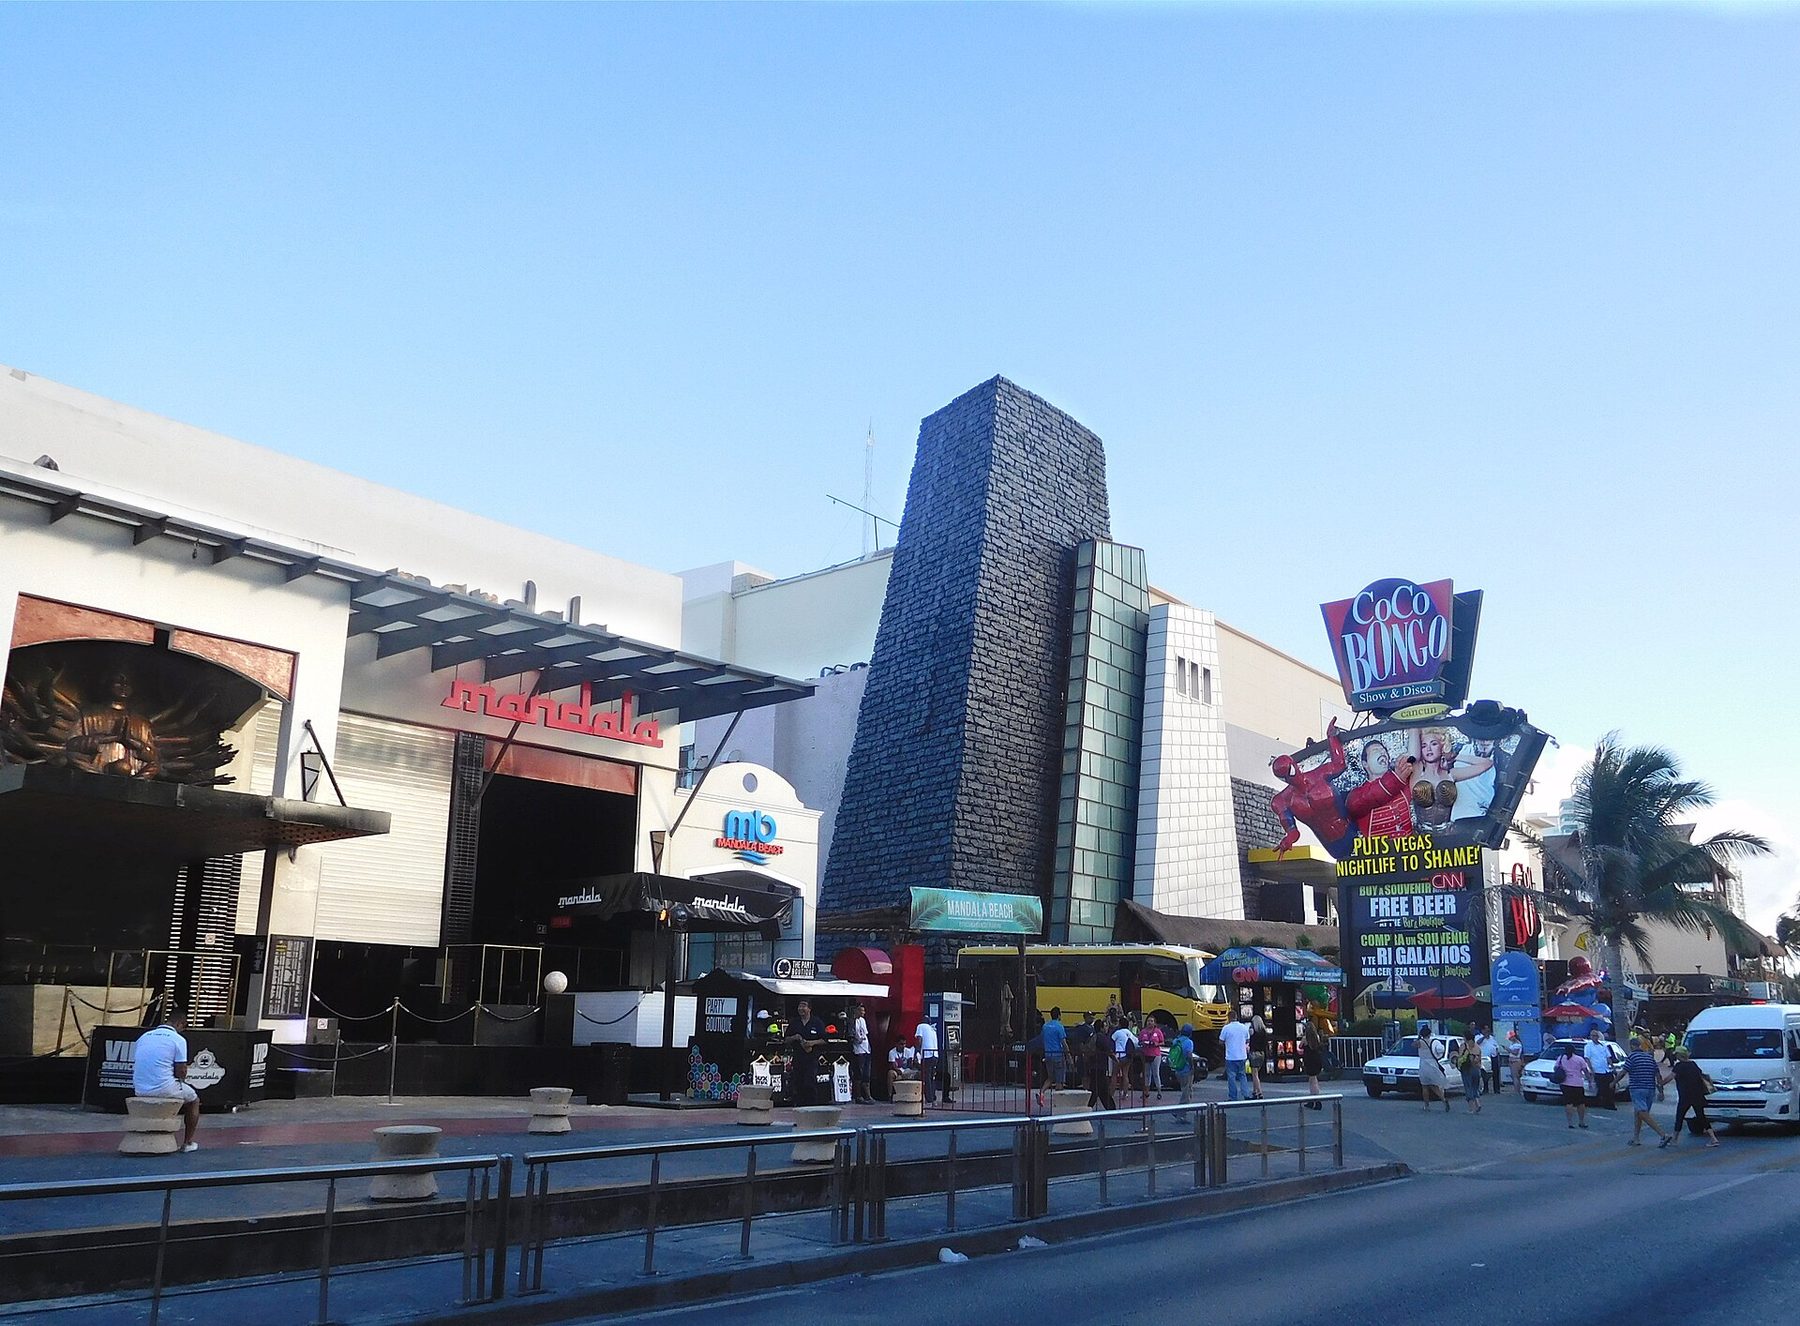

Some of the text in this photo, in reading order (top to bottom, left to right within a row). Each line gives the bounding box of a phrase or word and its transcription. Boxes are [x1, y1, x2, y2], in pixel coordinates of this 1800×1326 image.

[1352, 585, 1430, 625] CoCo
[1342, 615, 1448, 693] BONGO
[1359, 684, 1433, 704] Show & Disco
[441, 679, 664, 749] mandala
[1400, 706, 1437, 719] cancun
[725, 810, 777, 843] mb
[717, 837, 784, 855] MANDALA BEACH
[1353, 834, 1433, 856] PUTS VEGAS
[1336, 856, 1396, 877] NIGHTLIFE
[1402, 854, 1419, 872] TO
[1359, 885, 1378, 896] BUY
[1384, 882, 1431, 895] SOUVENIR
[1432, 871, 1464, 889] CNN
[558, 885, 602, 908] mandala
[691, 894, 746, 914] mandala
[1370, 894, 1457, 918] FREE BEER
[947, 899, 1014, 919] MANDALA BEACH
[1361, 956, 1367, 966] Y
[1367, 956, 1376, 965] TE
[1361, 967, 1376, 976] UNA
[1409, 967, 1419, 976] EN
[1419, 966, 1428, 976] EL
[706, 998, 726, 1014] PARTY
[705, 1016, 733, 1034] BOUTIQUE
[253, 1042, 269, 1064] VIP
[101, 1061, 135, 1071] SERVIC
[186, 1071, 220, 1081] mandala
